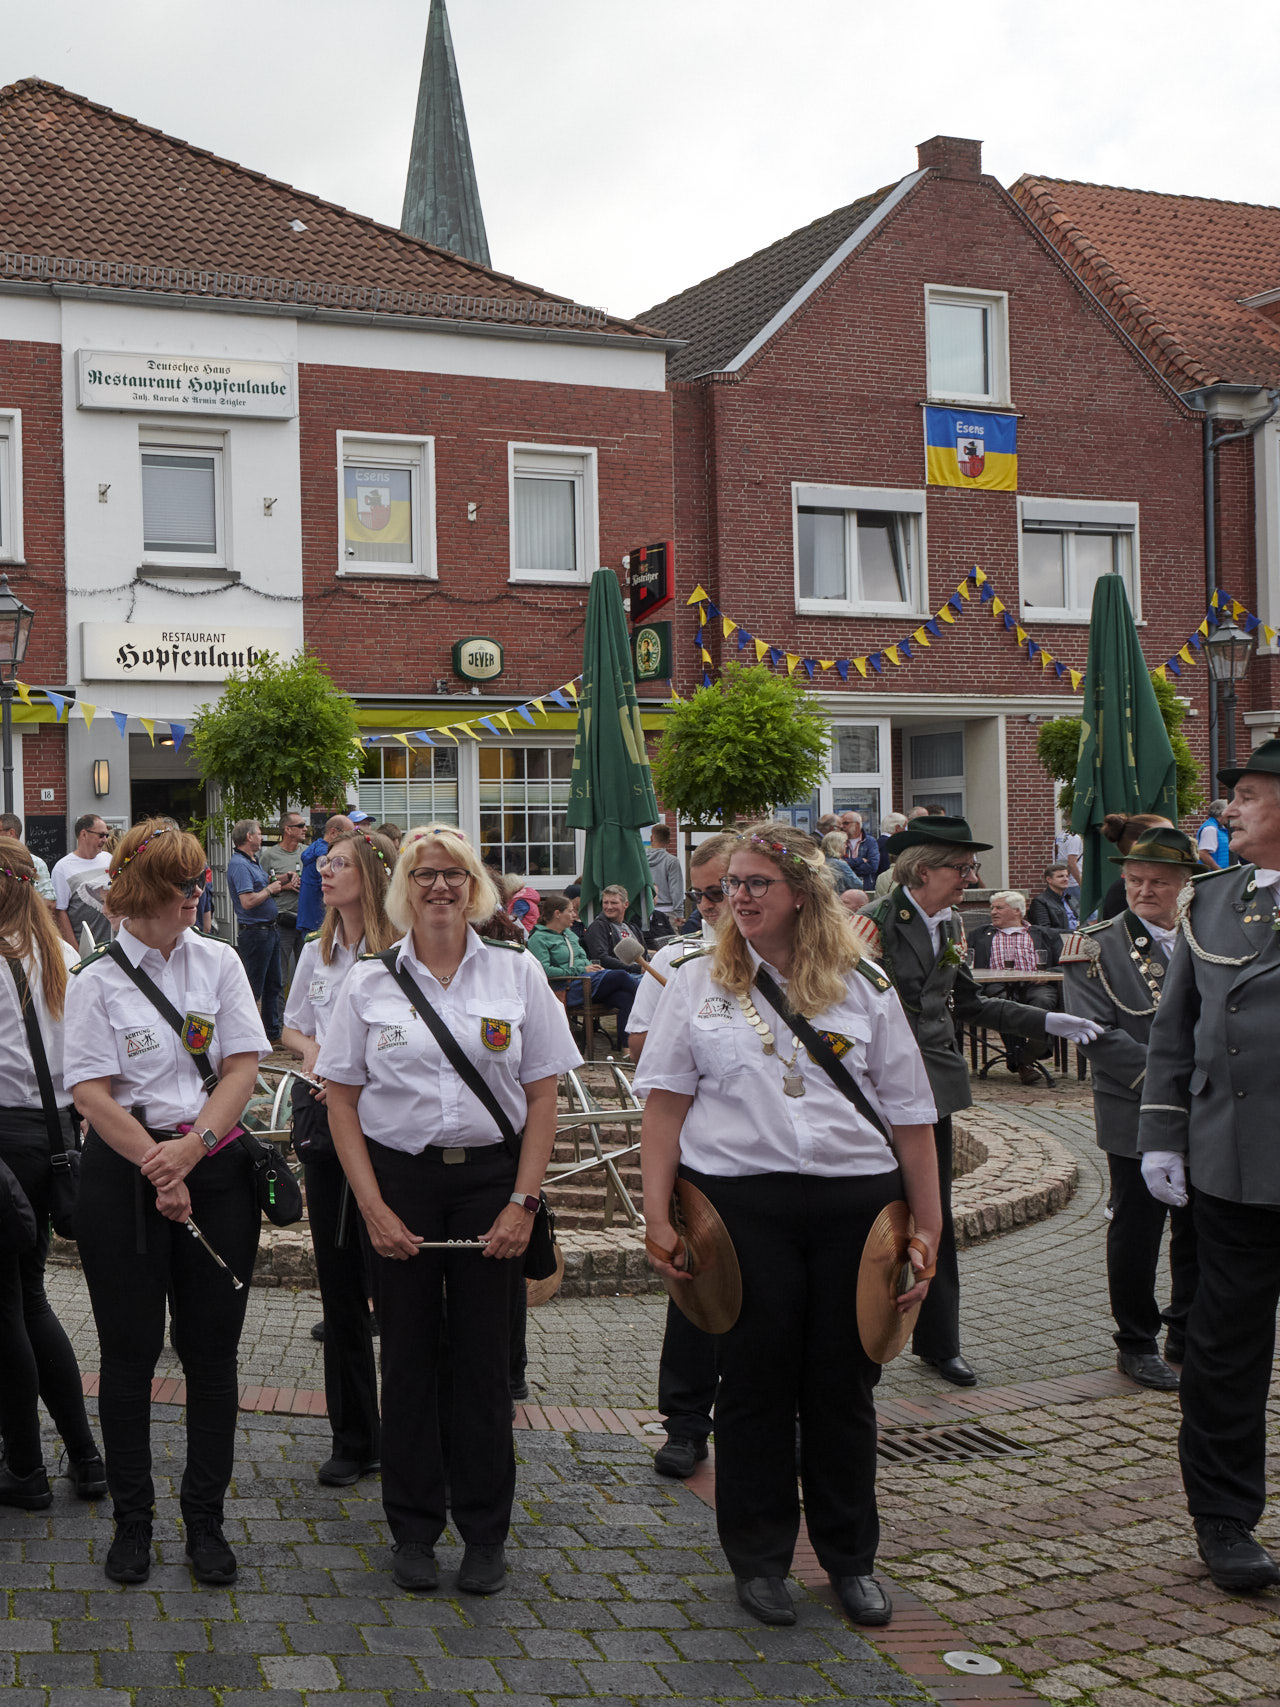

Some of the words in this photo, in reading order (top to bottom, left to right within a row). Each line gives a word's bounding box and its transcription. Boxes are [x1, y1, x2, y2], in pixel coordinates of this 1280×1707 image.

[147, 360, 199, 373] Deutsches
[202, 364, 231, 375] Haus
[88, 369, 182, 389] Restaurant
[188, 376, 287, 397] Hopfenlaube
[182, 395, 189, 403] &
[956, 421, 985, 435] Esens
[355, 469, 390, 482] Esens
[161, 631, 227, 643] RESTAURANT
[116, 643, 271, 673] Hopfenlaub
[468, 651, 495, 668] JEVER
[44, 790, 52, 800] 18
[125, 1029, 151, 1040] ACHTUNG
